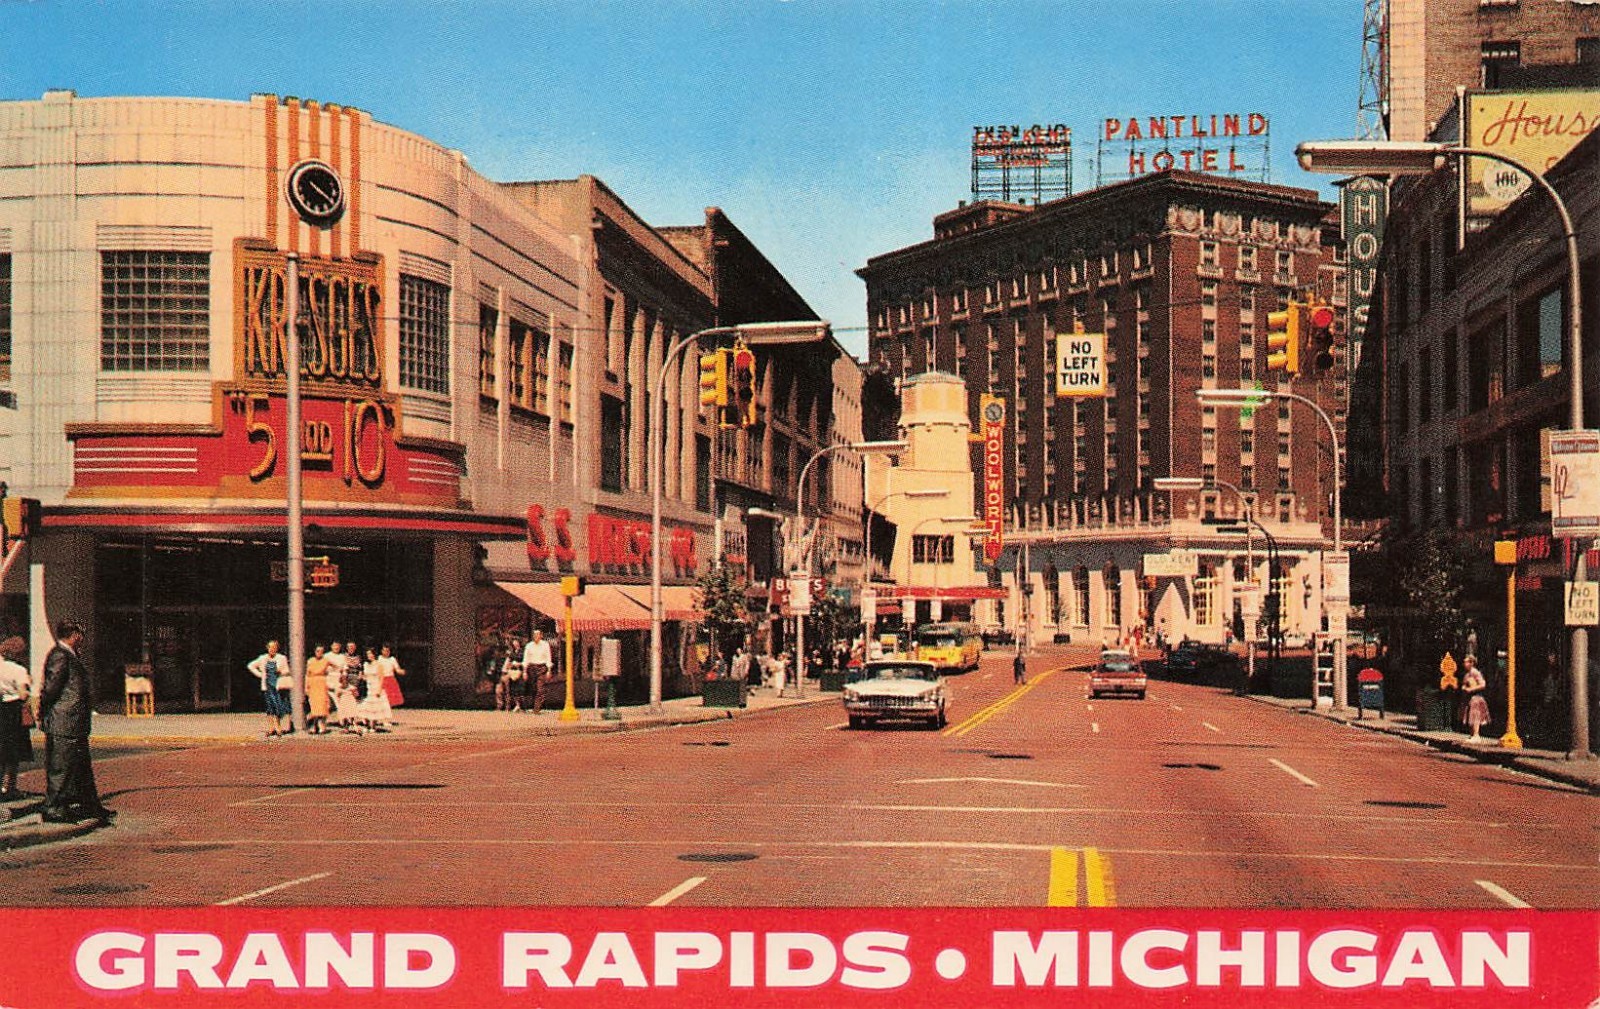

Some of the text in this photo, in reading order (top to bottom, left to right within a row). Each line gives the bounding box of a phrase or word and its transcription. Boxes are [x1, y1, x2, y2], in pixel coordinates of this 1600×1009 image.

[1105, 113, 1266, 140] PANTLIND
[1128, 150, 1244, 173] HOTEL
[1071, 341, 1091, 354] NO
[1064, 357, 1098, 370] LEFT
[1061, 372, 1099, 385] TURN
[300, 420, 333, 452] ND
[987, 418, 1000, 544] WOOLWORTH
[1572, 587, 1590, 597] NO
[1569, 610, 1596, 619] TURN
